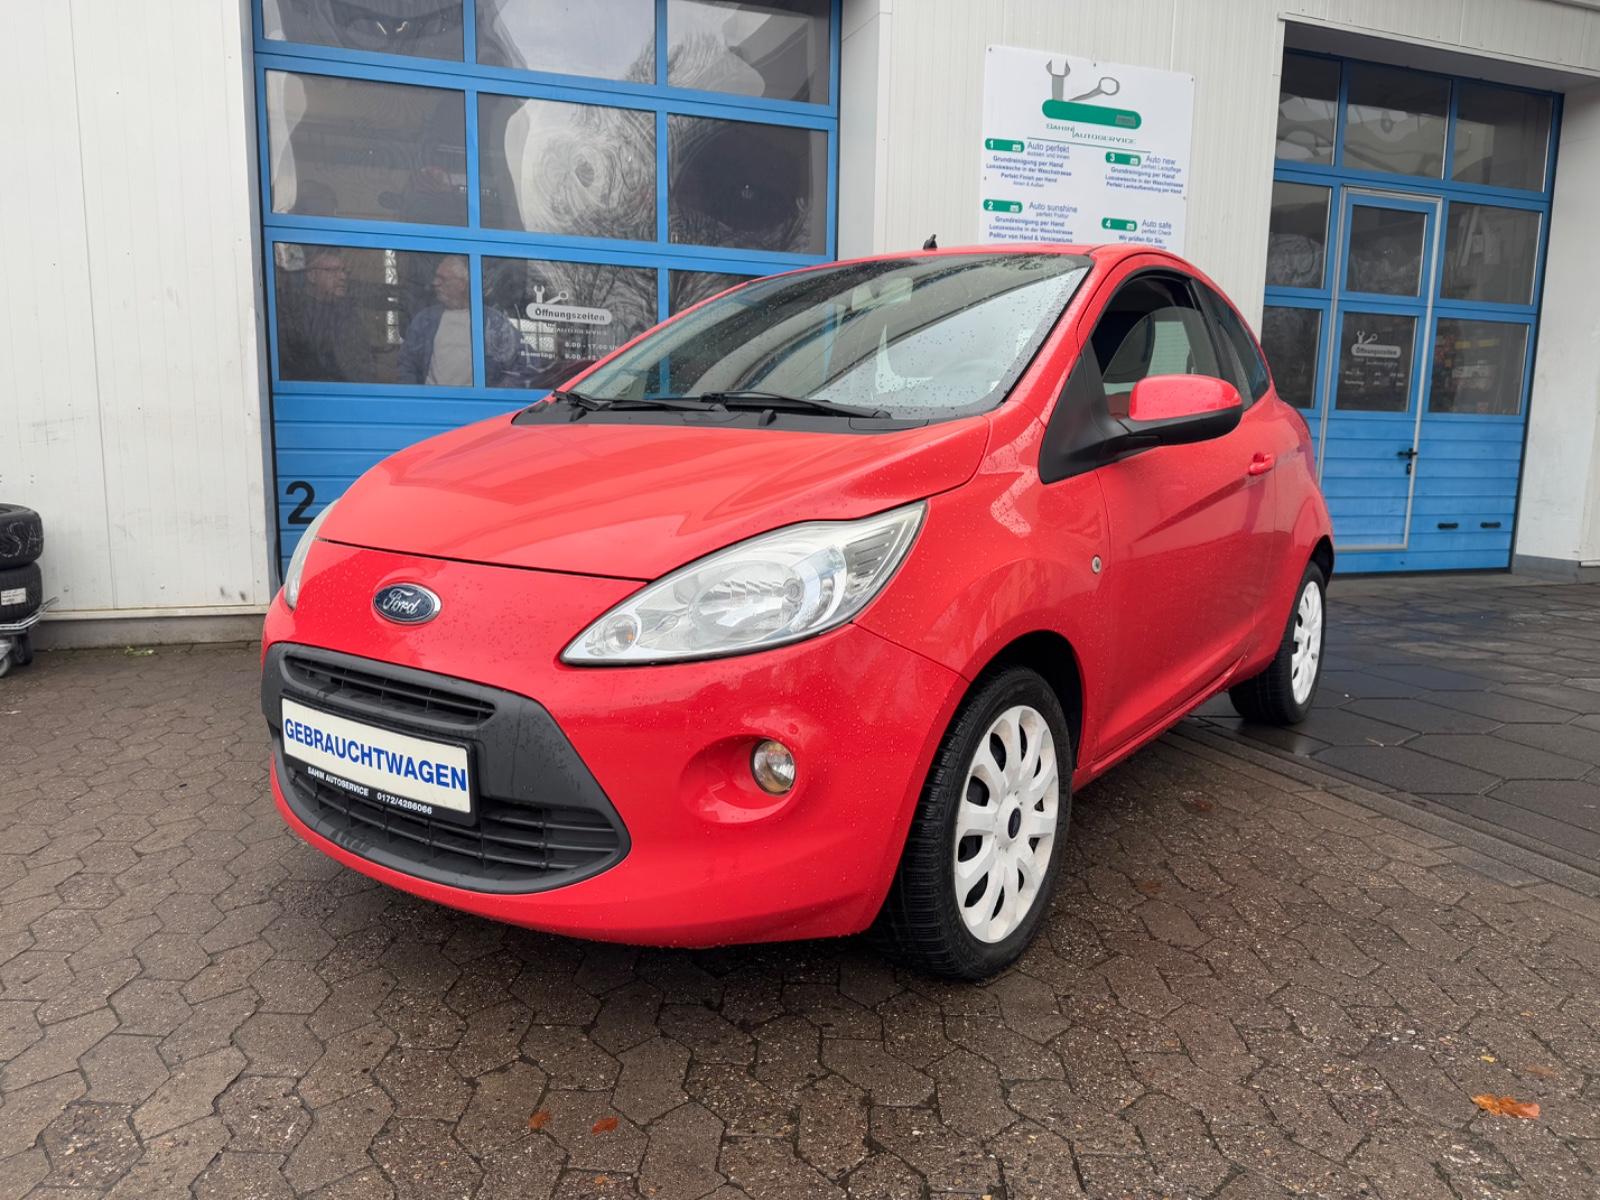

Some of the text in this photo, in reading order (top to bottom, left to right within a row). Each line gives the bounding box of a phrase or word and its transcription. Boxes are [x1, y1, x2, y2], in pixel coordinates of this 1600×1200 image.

[989, 140, 994, 149] 1
[1027, 141, 1070, 153] Auto perfekt
[993, 155, 1037, 166] Grundreinigung
[1048, 160, 1064, 168] Hand
[1109, 153, 1115, 161] 3
[1111, 166, 1151, 178] Grundreinigung
[987, 201, 994, 210] 2
[1029, 202, 1078, 213] Auto sunshine
[995, 216, 1039, 226] Grundreinigung
[1050, 219, 1065, 227] Hand
[1105, 220, 1111, 228] 4
[1142, 219, 1172, 229] Auto safe
[1019, 233, 1034, 241] Hand
[535, 307, 605, 321] Öffnungszeiten
[286, 481, 316, 525] 2
[383, 588, 421, 614] Ford
[284, 718, 467, 792] GEBRAUCHTWAGEN
[325, 774, 369, 796] AUTOSERVICE
